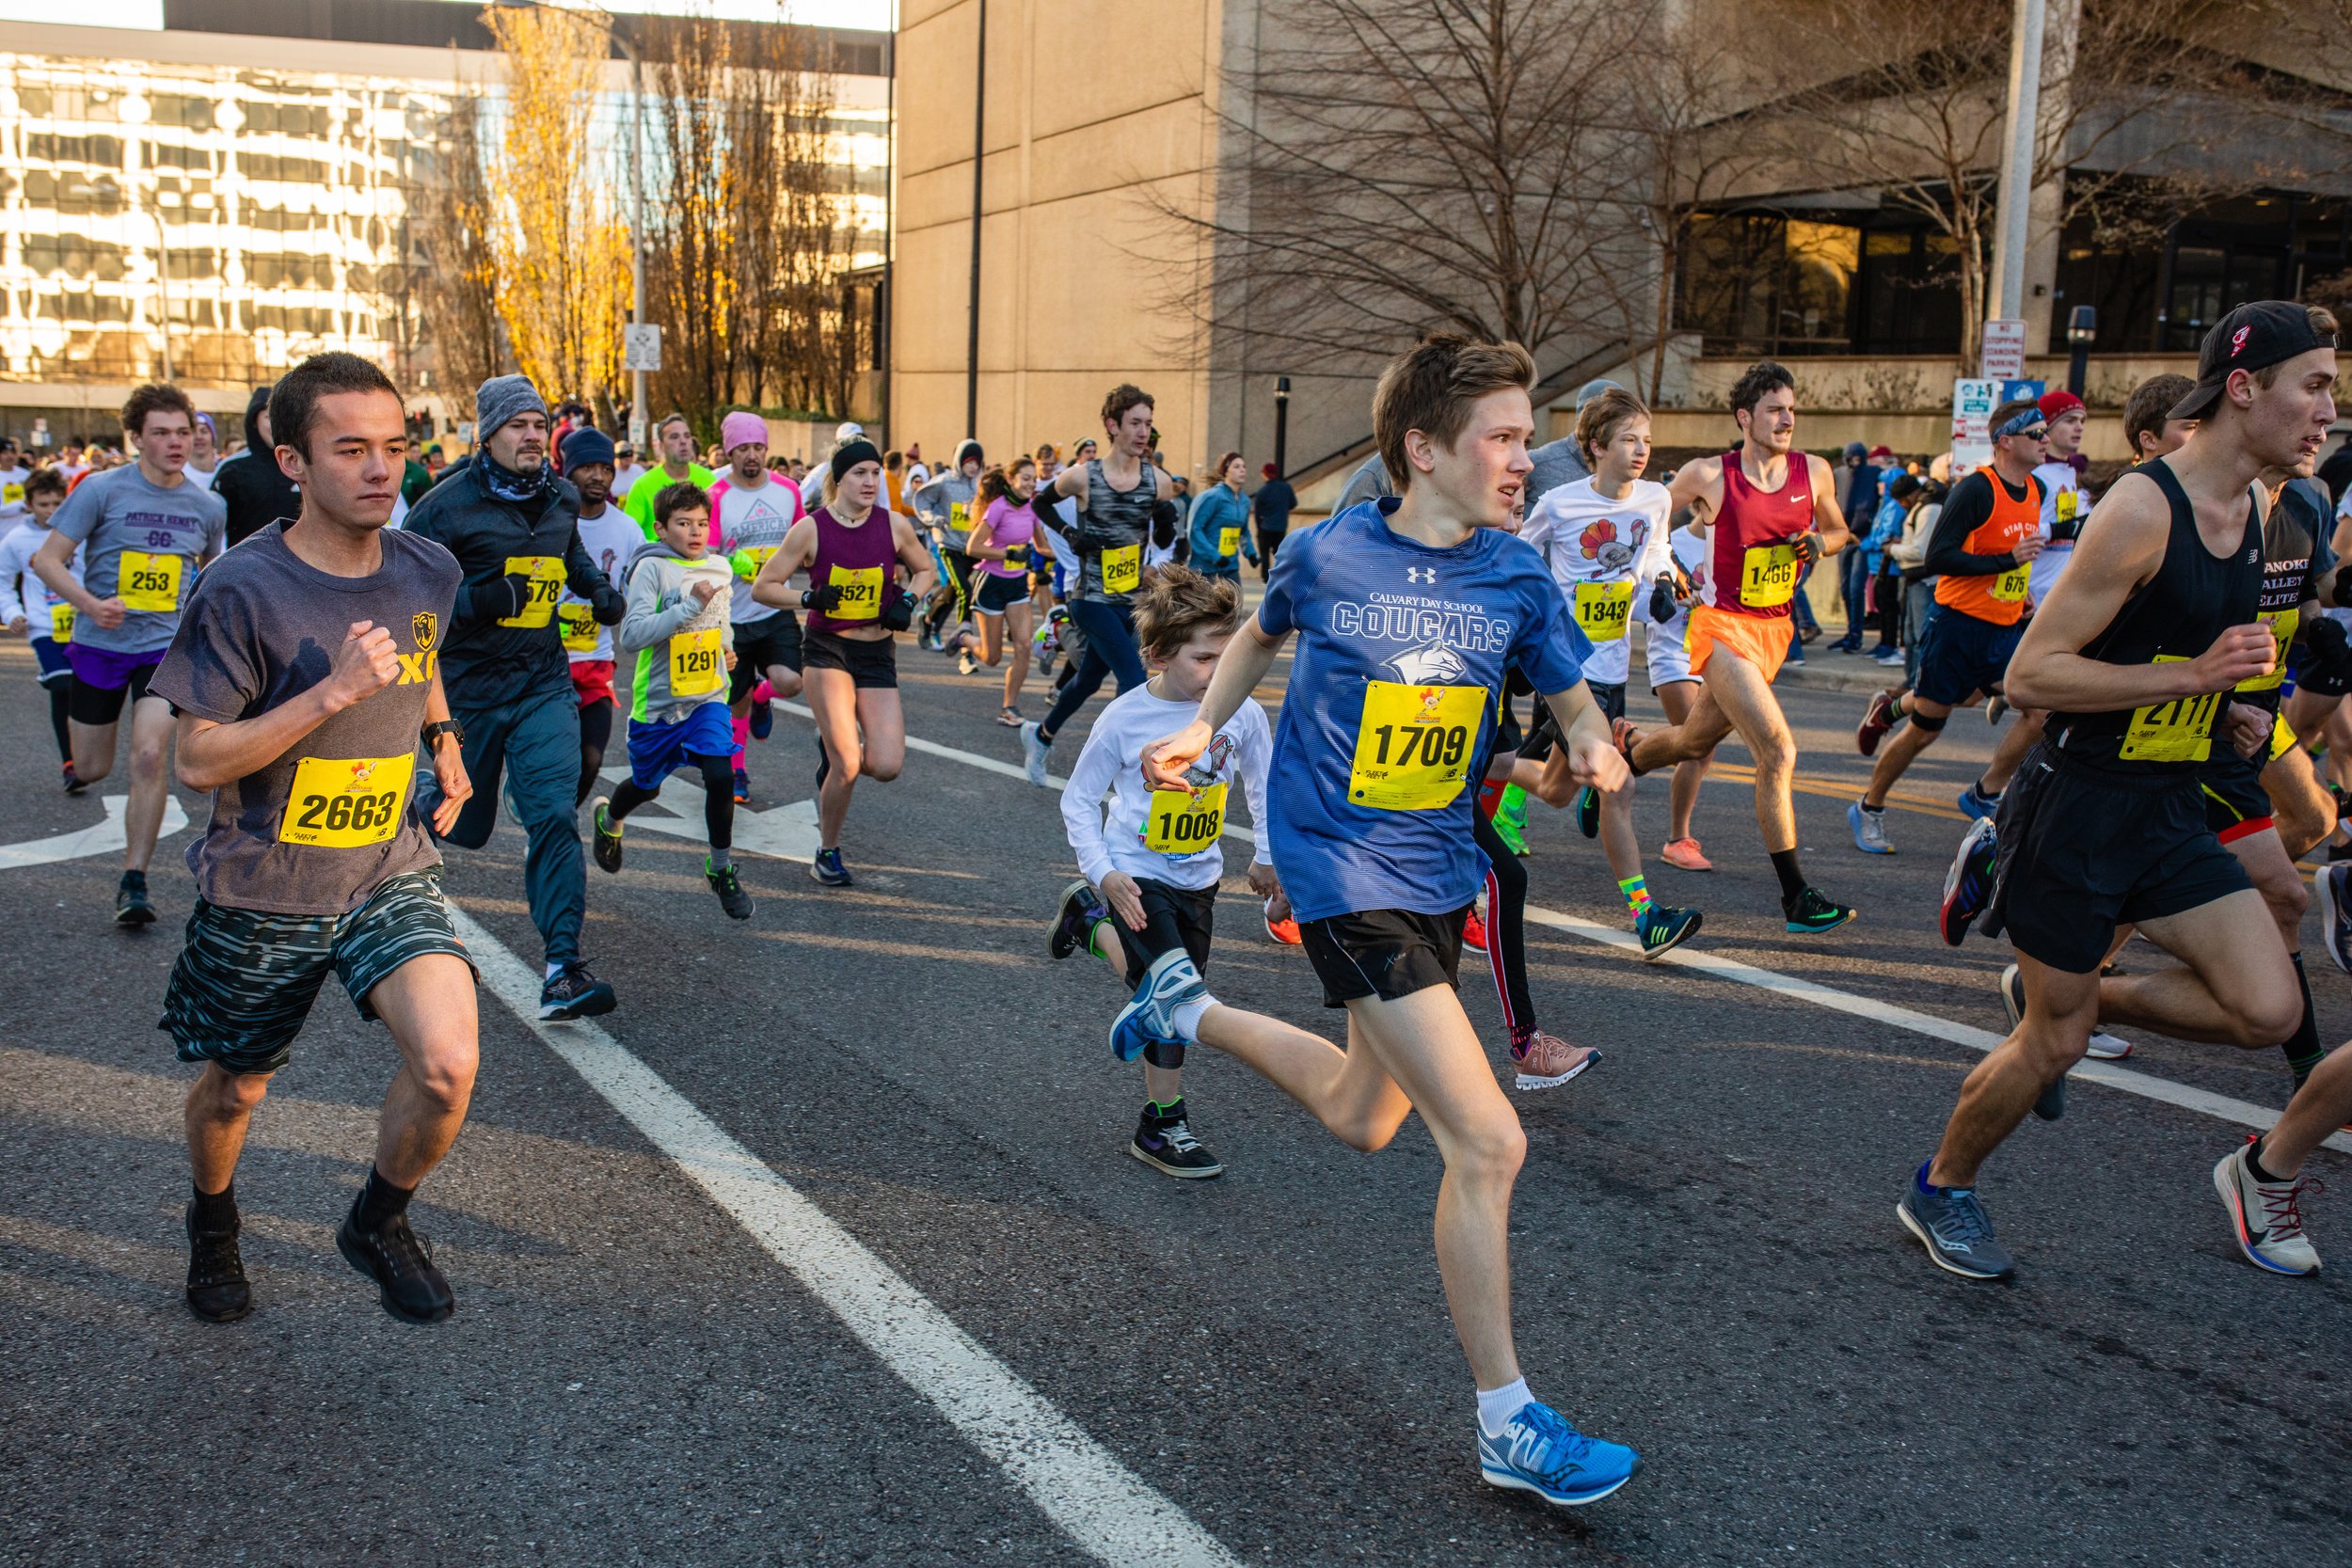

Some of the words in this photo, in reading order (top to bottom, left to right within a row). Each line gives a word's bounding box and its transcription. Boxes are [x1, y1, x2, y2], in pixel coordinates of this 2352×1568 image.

[1986, 359, 2018, 368] PARKING
[125, 512, 165, 524] PATRICK
[167, 515, 198, 528] HENRY
[2004, 522, 2022, 537] STAR
[1107, 558, 1136, 579] 2625
[1751, 562, 1791, 585] 1466
[2264, 559, 2309, 574] ANOKE
[132, 571, 169, 591] 253
[2004, 576, 2026, 594] 675
[2262, 576, 2305, 590] ALLEY
[1370, 593, 1419, 607] CALVARY
[1421, 597, 1441, 610] DAY
[1443, 600, 1485, 614] SCHOOL
[1581, 600, 1628, 622] 1343
[1332, 601, 1510, 653] COUGARS
[676, 648, 717, 673] 1291
[2143, 694, 2213, 726] 2111
[1375, 724, 1467, 767] 1709
[296, 791, 397, 831] 2663
[1160, 810, 1219, 841] 1008
